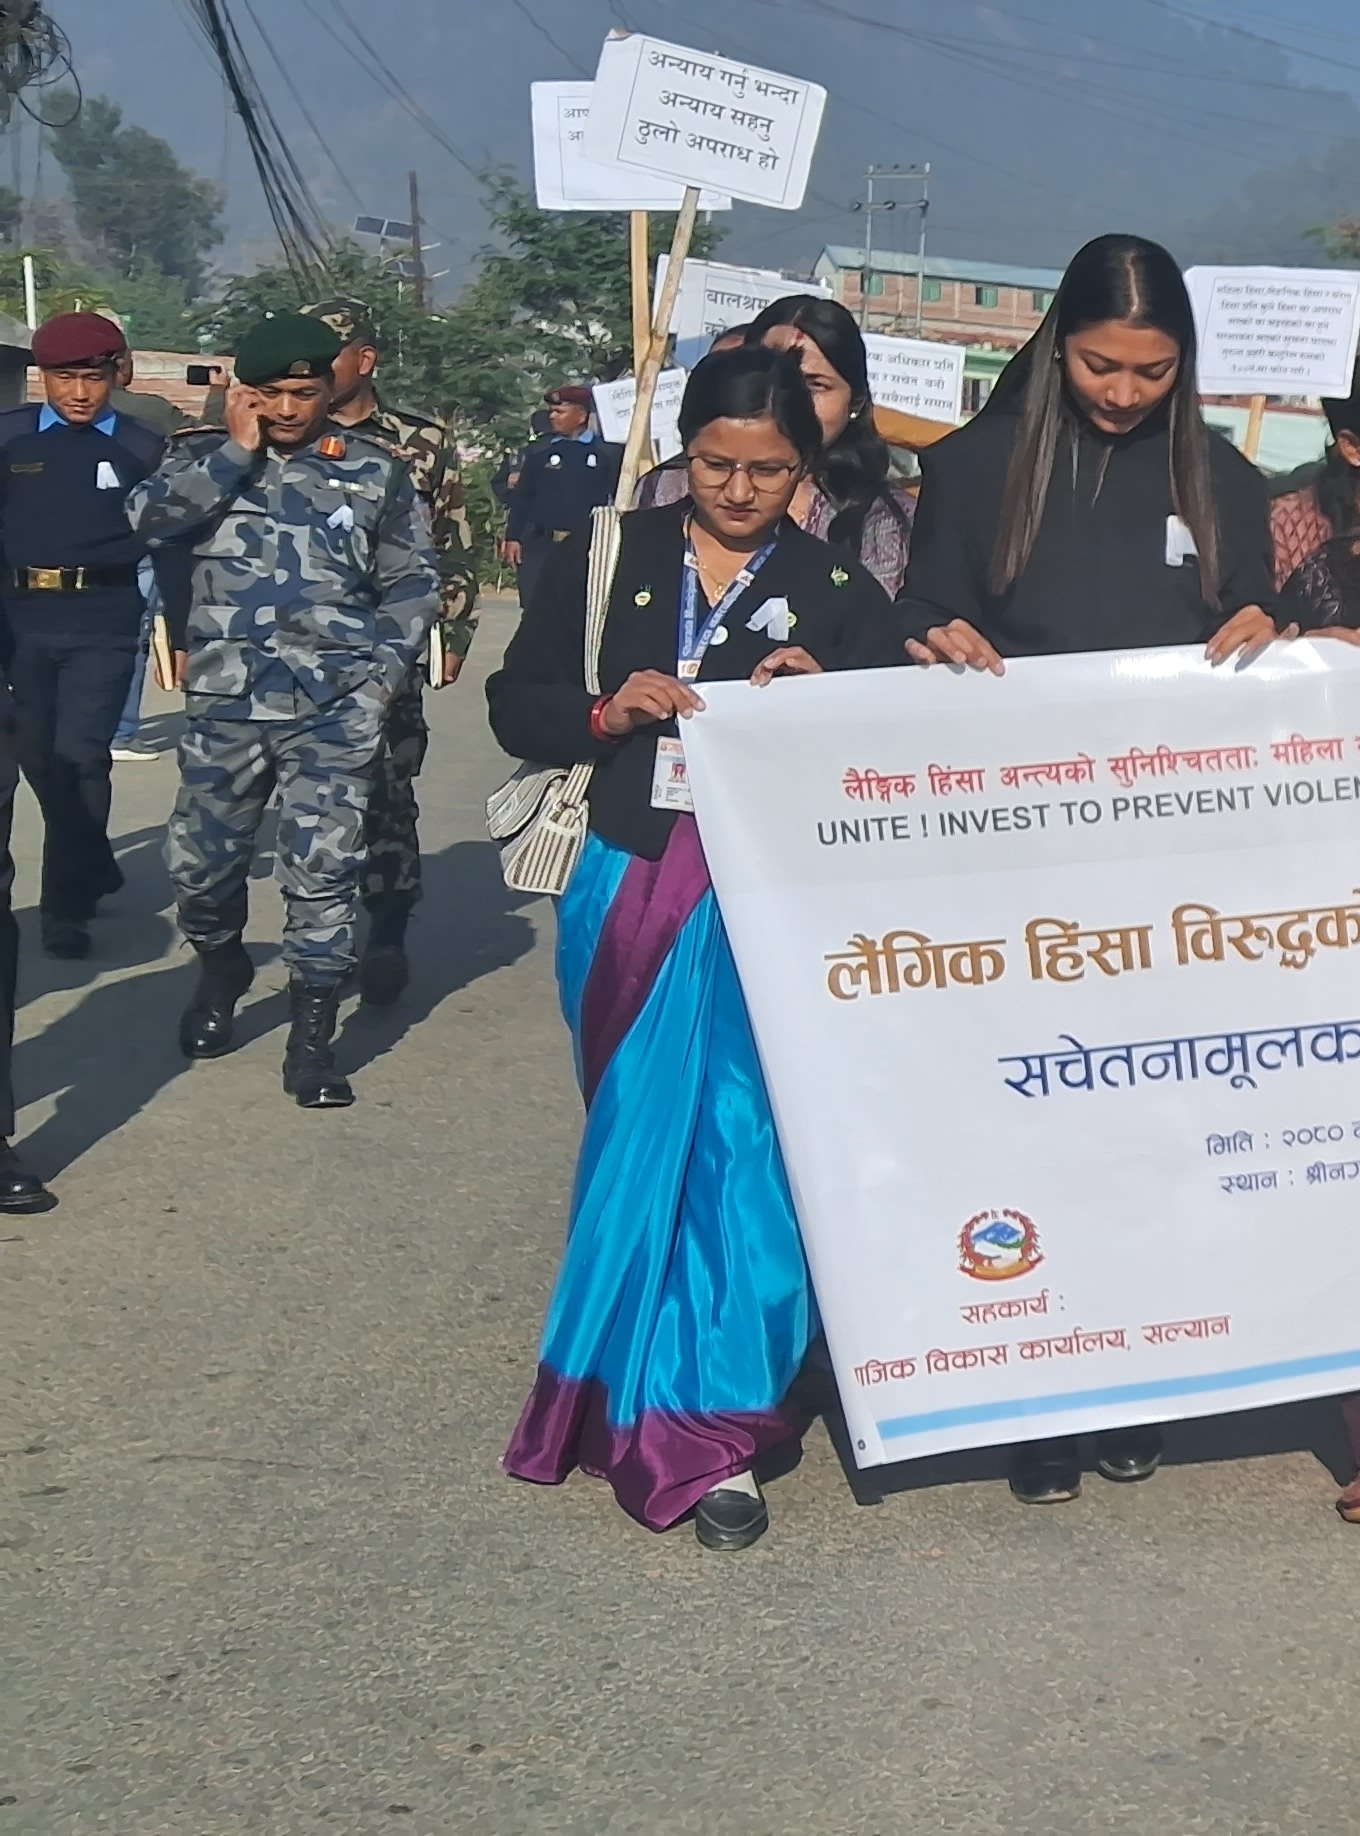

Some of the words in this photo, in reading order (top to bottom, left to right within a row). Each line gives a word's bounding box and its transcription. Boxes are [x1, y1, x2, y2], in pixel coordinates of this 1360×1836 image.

[649, 50, 714, 81] अन्याय
[719, 68, 750, 98] गर्नु
[754, 79, 799, 104] भन्दा
[659, 90, 724, 120] अन्याय
[730, 107, 775, 142] सहनु
[638, 119, 680, 144] ठुलो
[686, 131, 753, 163] अपराध
[758, 147, 780, 170] हो
[928, 764, 985, 797] हिंसा
[1000, 753, 1095, 788] अन्त्यको
[1270, 731, 1344, 765] महिला
[816, 815, 910, 846] UNITE
[920, 814, 928, 839] !
[940, 804, 1050, 836] INVEST
[1060, 799, 1102, 826] TO
[1112, 786, 1254, 822] PREVENT
[824, 929, 1007, 1002] लैंगिक
[1024, 916, 1154, 984] हिंसा
[1206, 1130, 1254, 1156] मिति
[1282, 1123, 1344, 1148] २०८०
[1219, 1169, 1278, 1194] स्थान
[960, 1287, 1050, 1325] सहकार्य
[926, 1342, 1008, 1376] विकास
[1018, 1325, 1132, 1362] कार्यालय,
[1142, 1314, 1232, 1346] सल्यान
